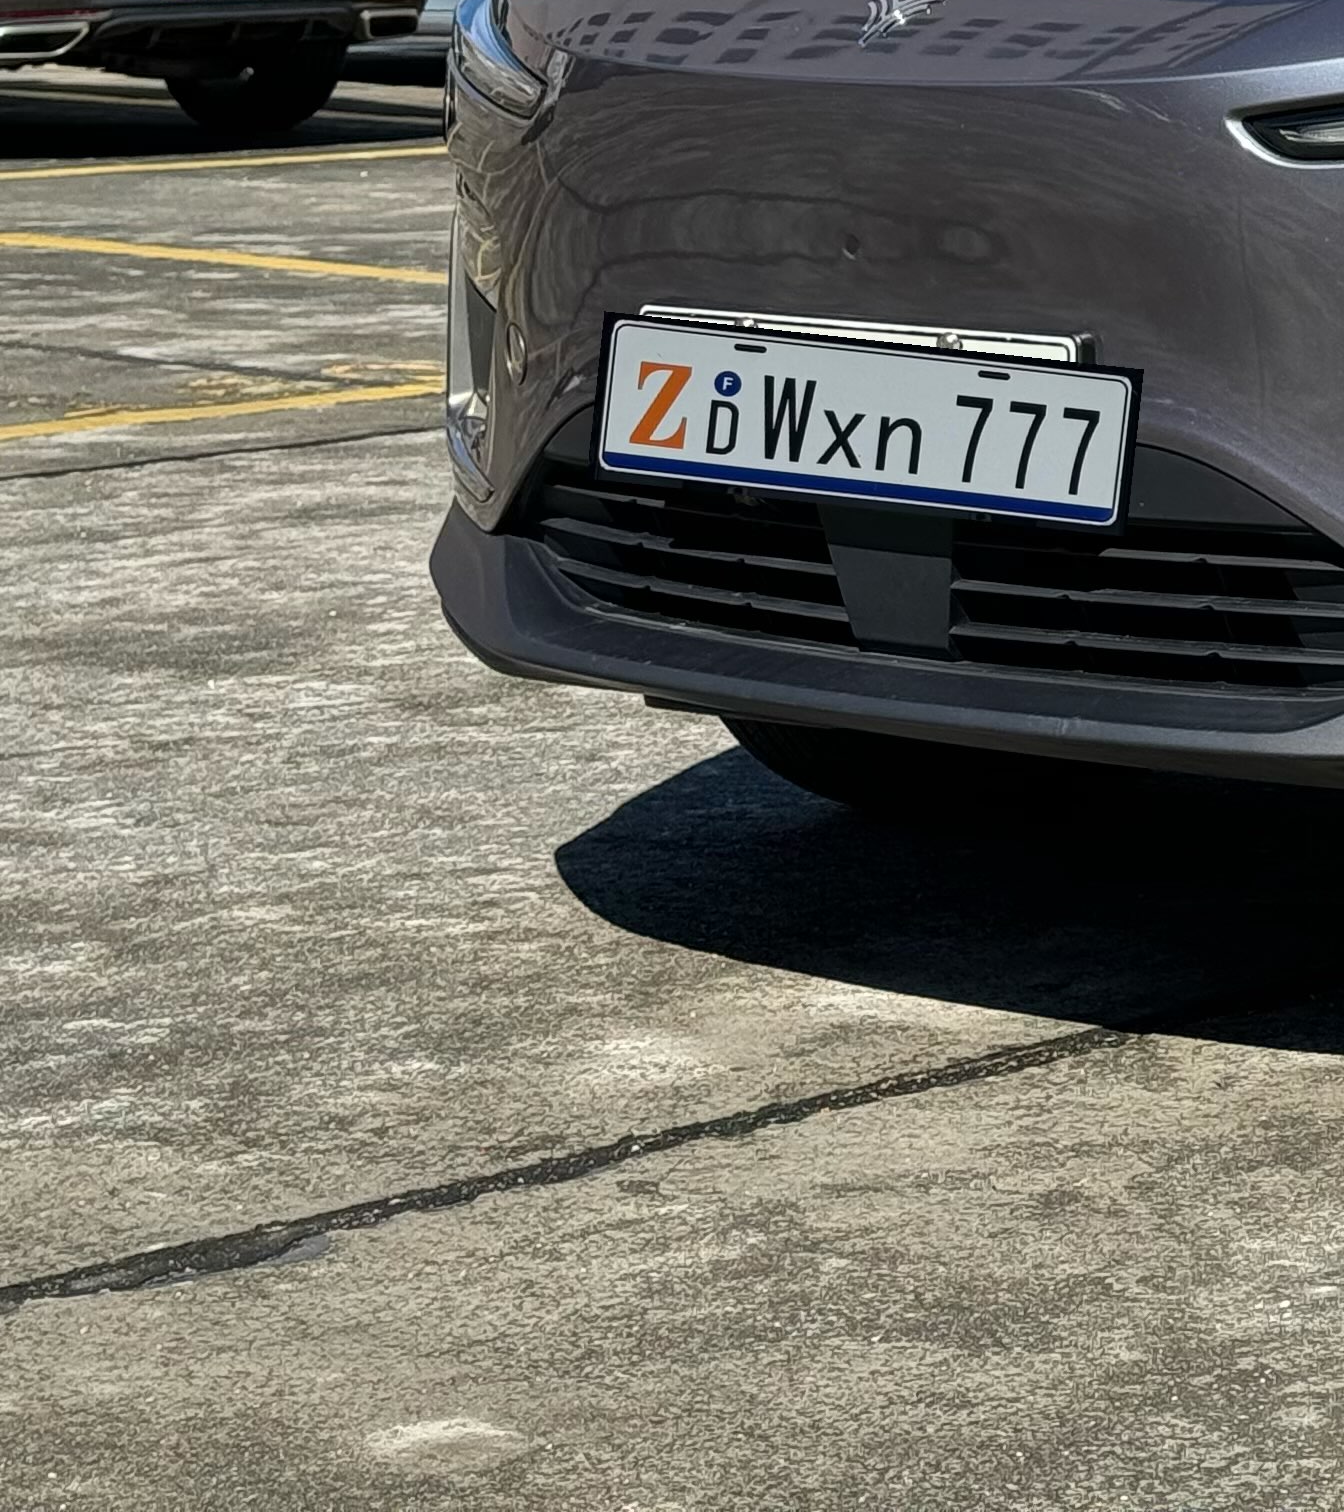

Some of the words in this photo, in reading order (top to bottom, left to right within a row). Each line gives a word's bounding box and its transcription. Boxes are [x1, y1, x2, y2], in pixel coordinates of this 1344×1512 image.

[629, 361, 692, 450] Z
[763, 375, 924, 475] Wxn
[955, 394, 1101, 496] 777
